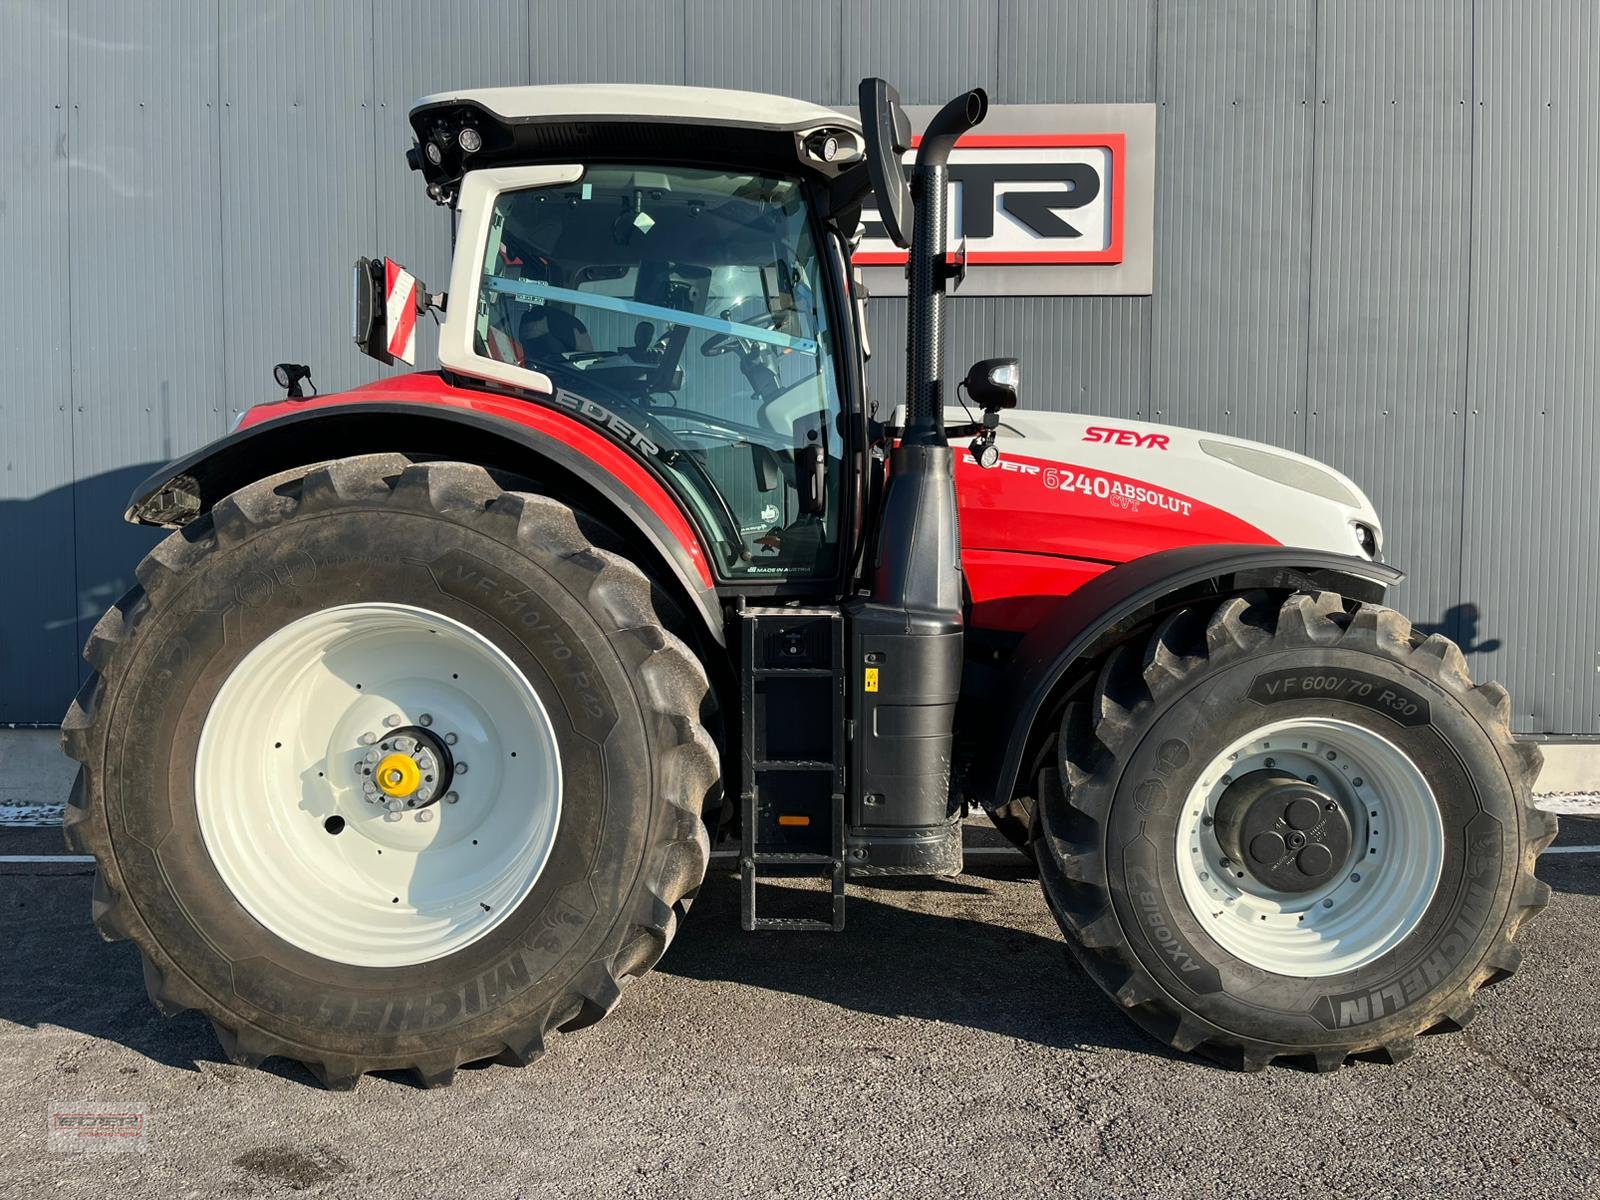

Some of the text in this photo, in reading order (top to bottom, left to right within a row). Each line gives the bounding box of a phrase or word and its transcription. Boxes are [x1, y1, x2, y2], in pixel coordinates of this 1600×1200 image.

[555, 387, 659, 457] EDER
[1082, 426, 1170, 450] STEYR
[1042, 467, 1110, 498] 6240
[1110, 480, 1192, 516] ABSOLUT
[1109, 494, 1139, 512] CVT
[1265, 678, 1297, 696] VF
[1378, 690, 1418, 717] R30
[1139, 890, 1201, 973] AXIOBIB
[1339, 881, 1493, 1028] MICHELIN
